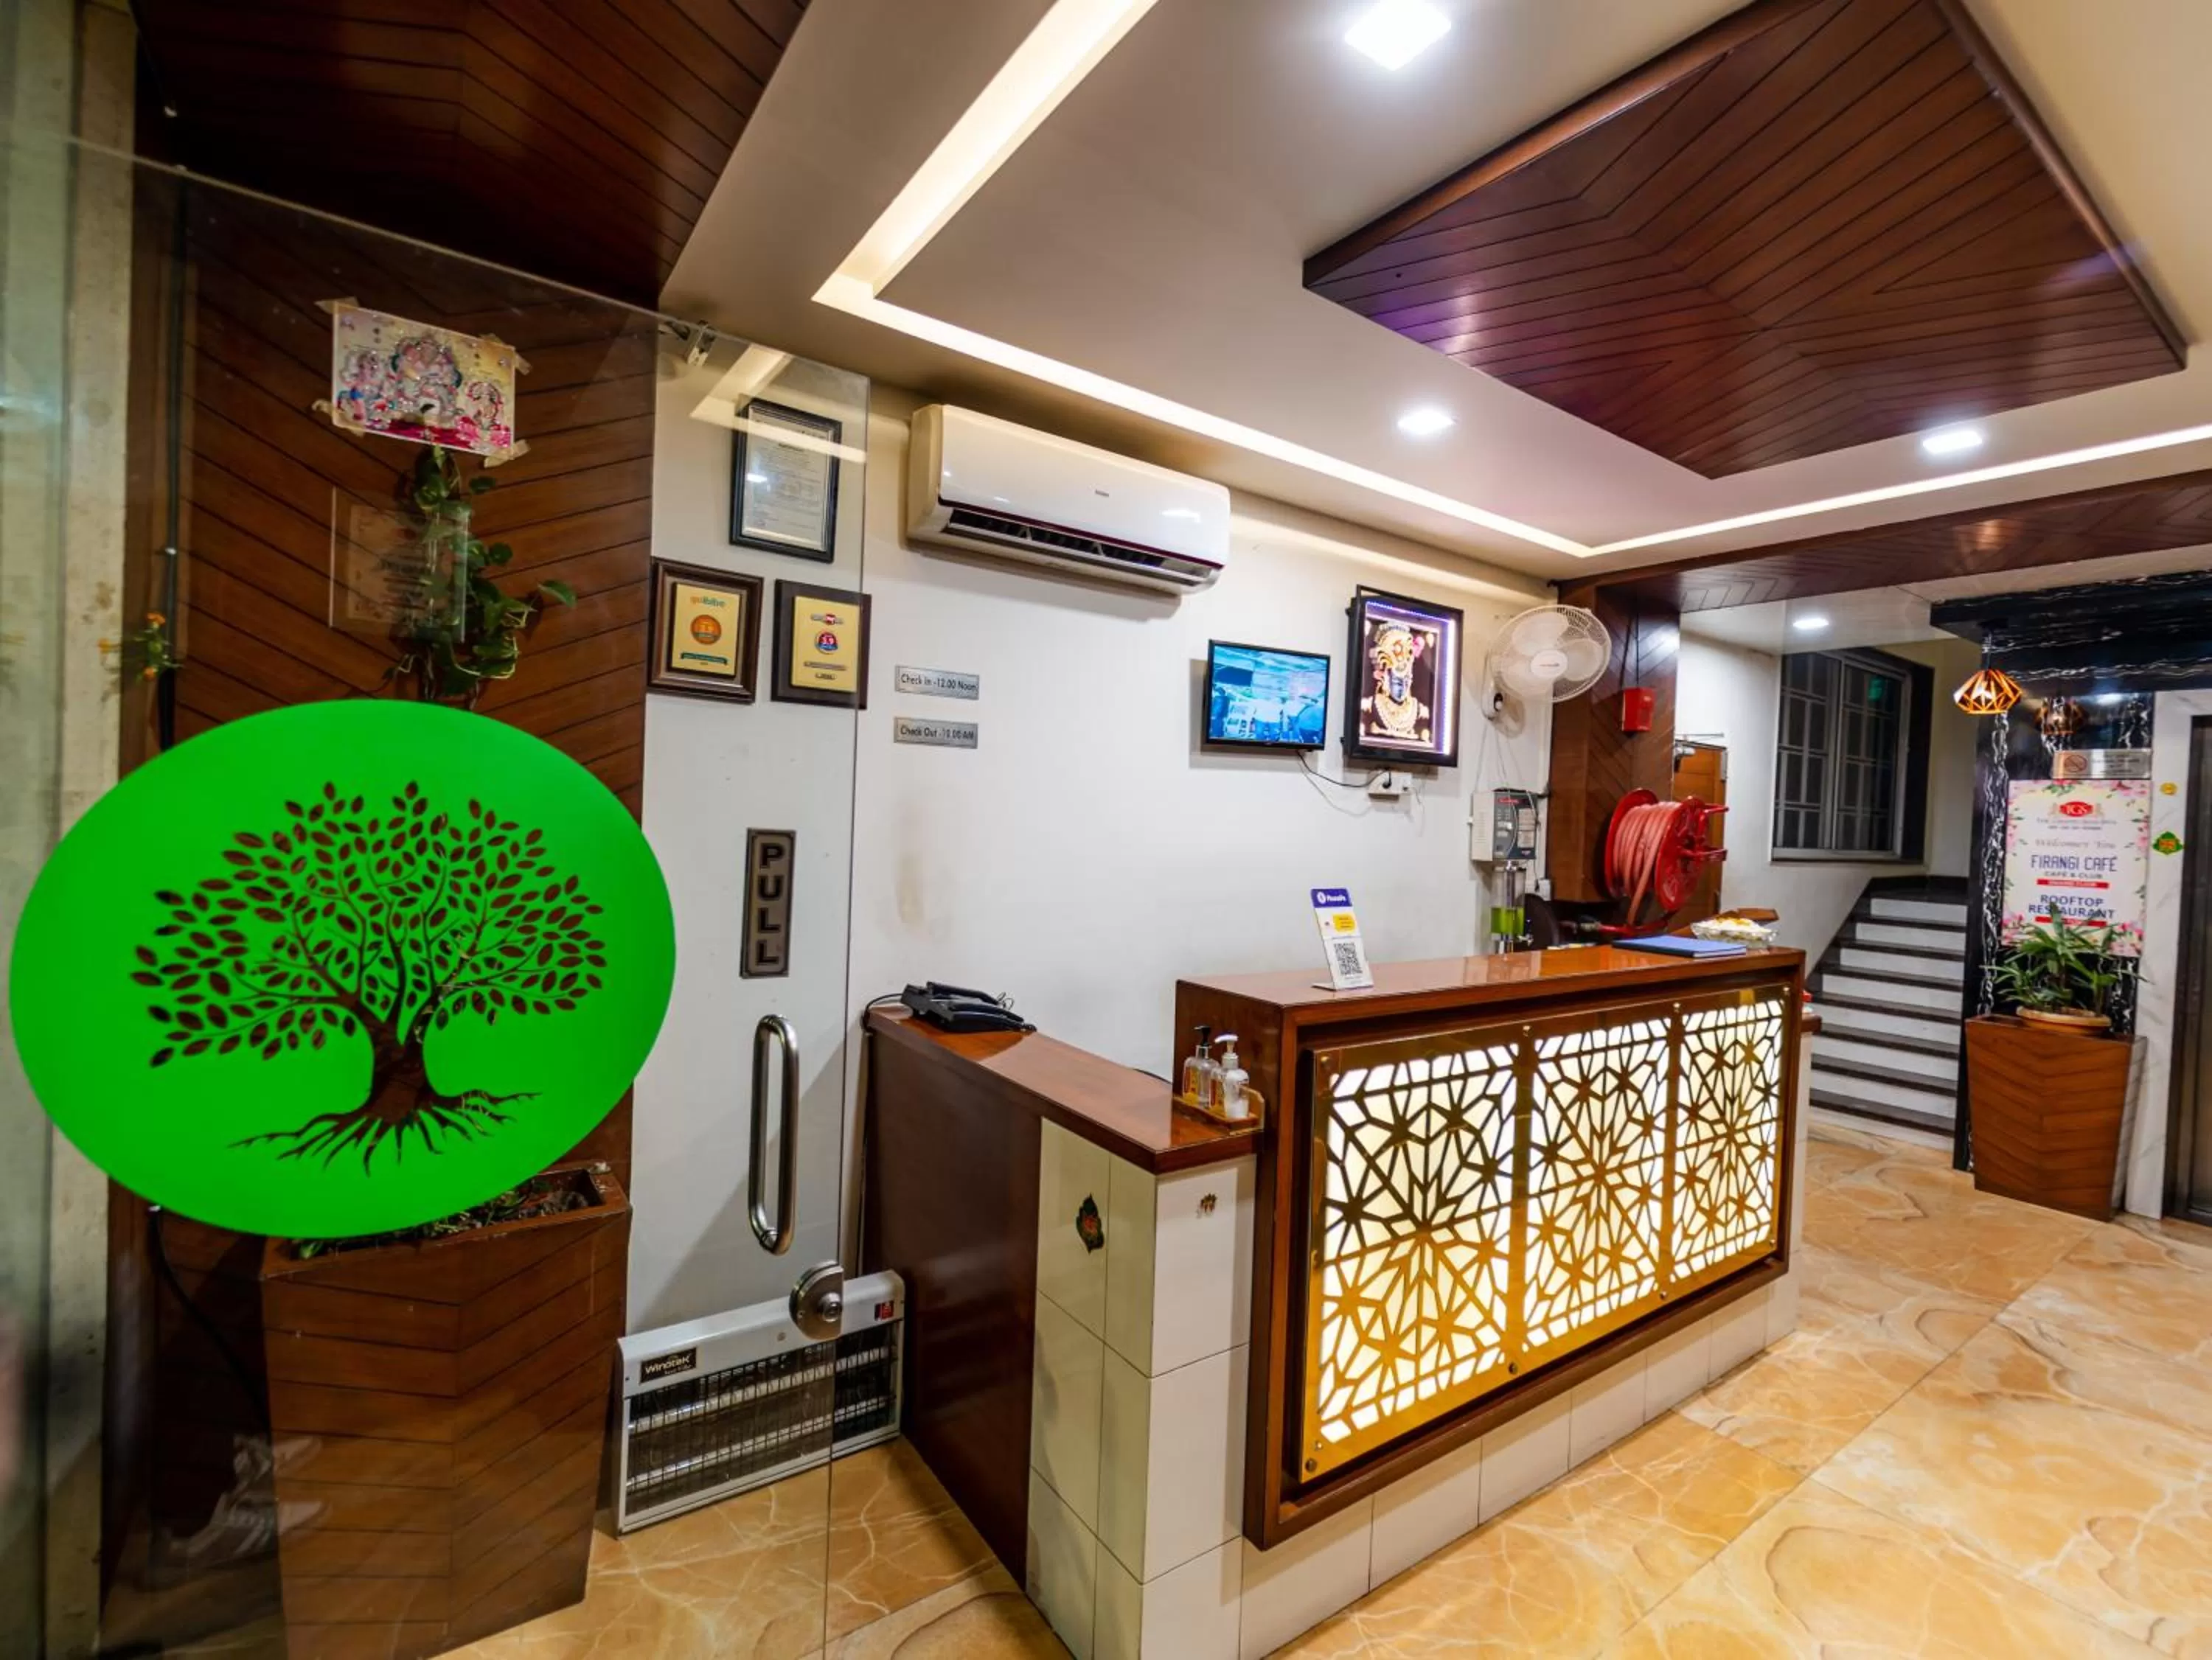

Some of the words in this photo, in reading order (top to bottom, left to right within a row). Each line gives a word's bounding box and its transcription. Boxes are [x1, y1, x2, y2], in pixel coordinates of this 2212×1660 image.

[901, 673, 922, 685] Check
[959, 680, 977, 691] Noon
[900, 725, 922, 736] Check
[924, 728, 937, 738] Out
[2031, 854, 2080, 870] FIRANGI
[755, 843, 785, 966] PULL
[2040, 894, 2104, 907] ROOFTOP
[2028, 904, 2115, 918] RESAURANT
